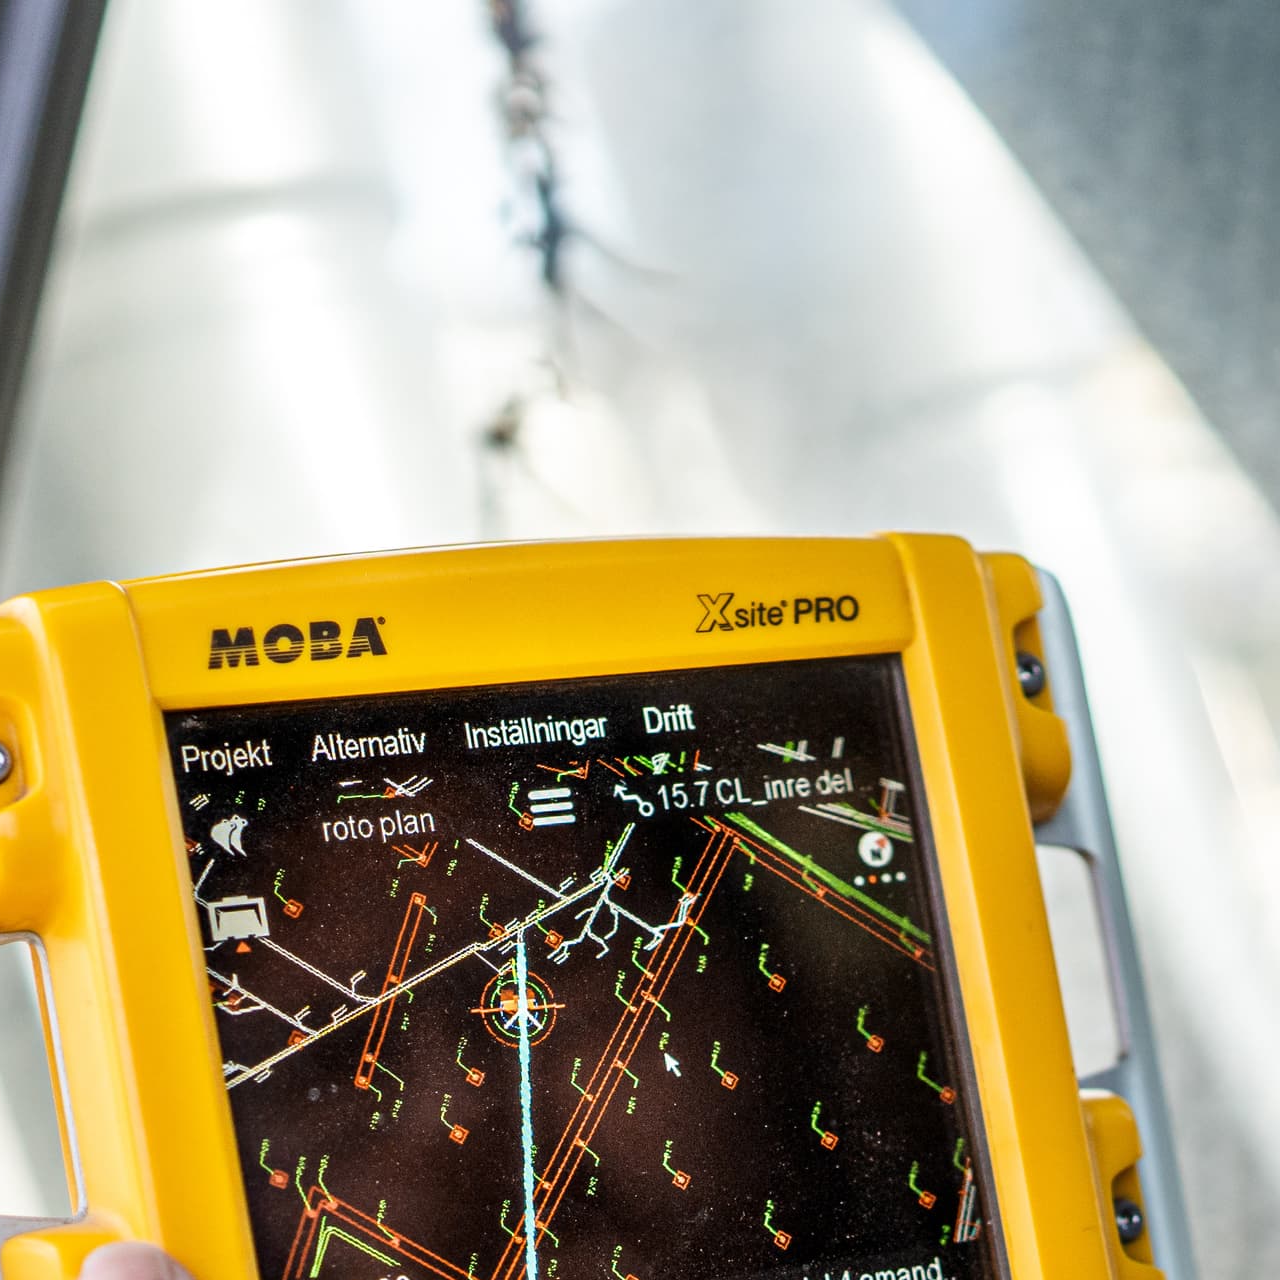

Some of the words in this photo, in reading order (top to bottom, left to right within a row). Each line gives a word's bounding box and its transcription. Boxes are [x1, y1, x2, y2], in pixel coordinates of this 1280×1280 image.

[794, 595, 859, 624] PRO
[181, 739, 272, 776] Projekt
[312, 727, 426, 761] Alternativ
[464, 715, 607, 749] Inställningar
[642, 705, 695, 734] Drift
[657, 780, 710, 810] 15.7
[715, 774, 811, 805] CL_inre
[322, 818, 374, 842] roto
[379, 811, 436, 843] plan
